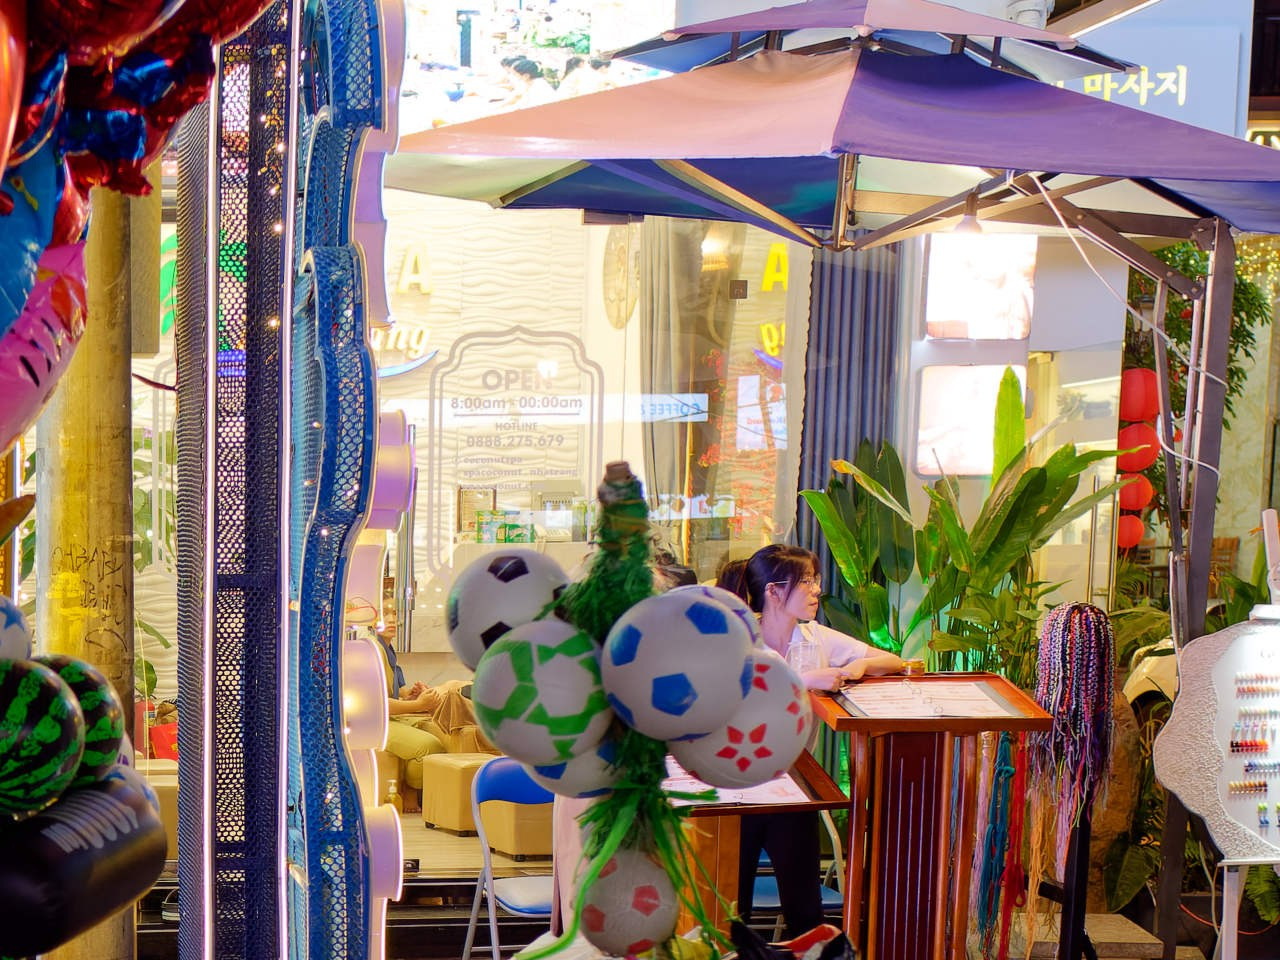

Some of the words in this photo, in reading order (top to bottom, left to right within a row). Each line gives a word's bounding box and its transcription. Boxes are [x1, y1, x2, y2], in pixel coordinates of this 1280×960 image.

[1083, 65, 1188, 106] 마사지
[481, 369, 553, 390] OPEN
[450, 396, 506, 410] 8:00am
[518, 395, 583, 409] 00:00am
[495, 422, 538, 432] HOTLINE
[466, 434, 565, 448] 0888.275.679
